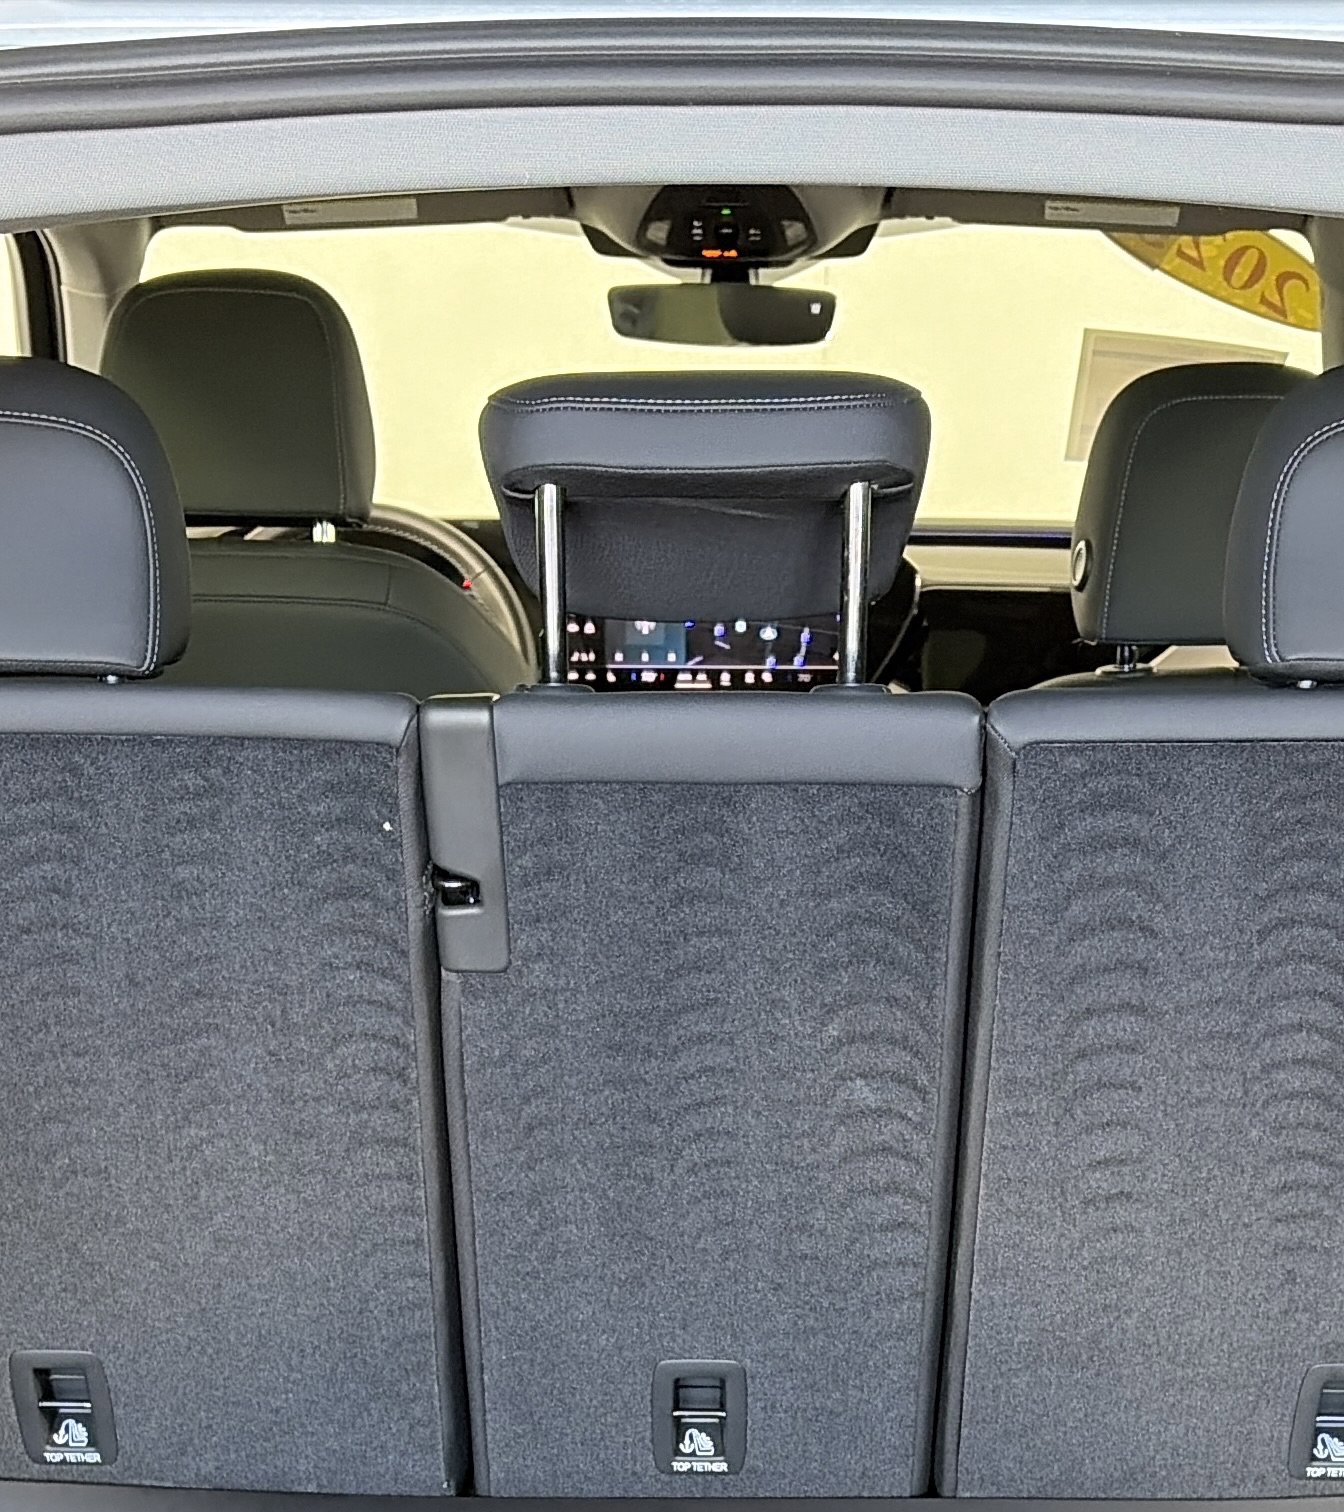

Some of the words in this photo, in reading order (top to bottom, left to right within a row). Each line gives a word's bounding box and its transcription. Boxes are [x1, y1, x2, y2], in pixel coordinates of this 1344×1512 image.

[43, 1452, 64, 1462] TOP
[63, 1452, 102, 1463] TETHER
[670, 1461, 691, 1472] TOP
[691, 1461, 728, 1472] TETHER
[1306, 1467, 1326, 1477] TOP
